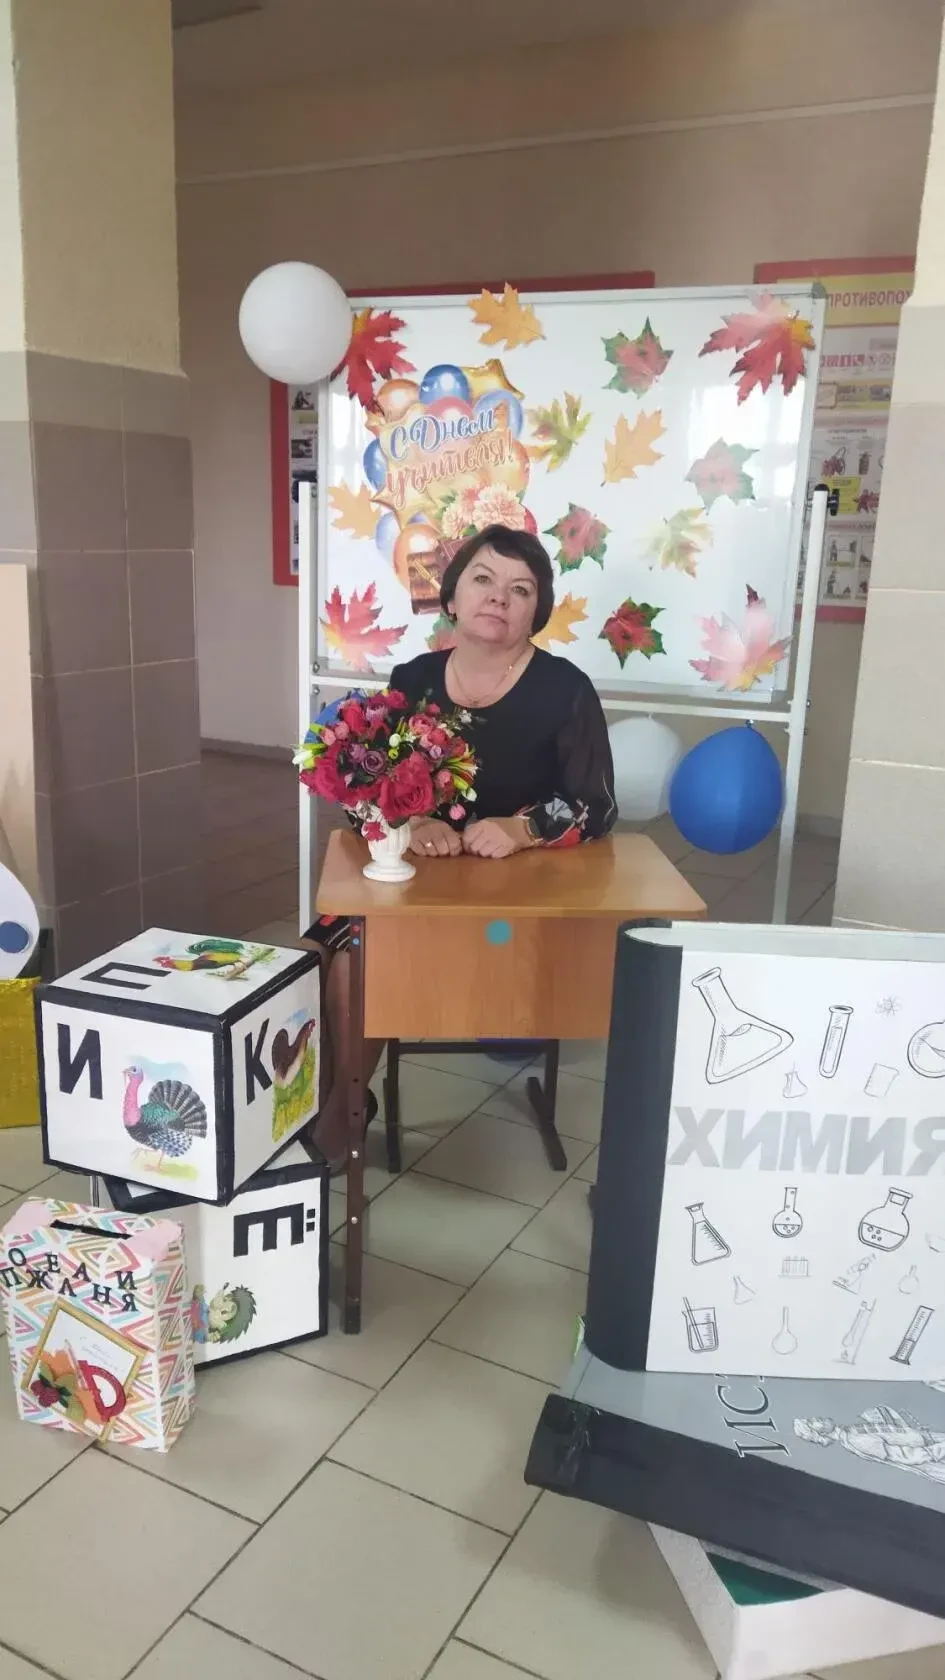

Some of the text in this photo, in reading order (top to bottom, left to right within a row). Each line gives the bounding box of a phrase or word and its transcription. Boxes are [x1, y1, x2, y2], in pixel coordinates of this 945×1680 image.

[389, 426, 407, 460] С
[57, 1023, 103, 1100] И
[244, 1018, 272, 1105] К
[667, 1106, 945, 1176] ХИМИЯ
[715, 1374, 791, 1459] ИС
